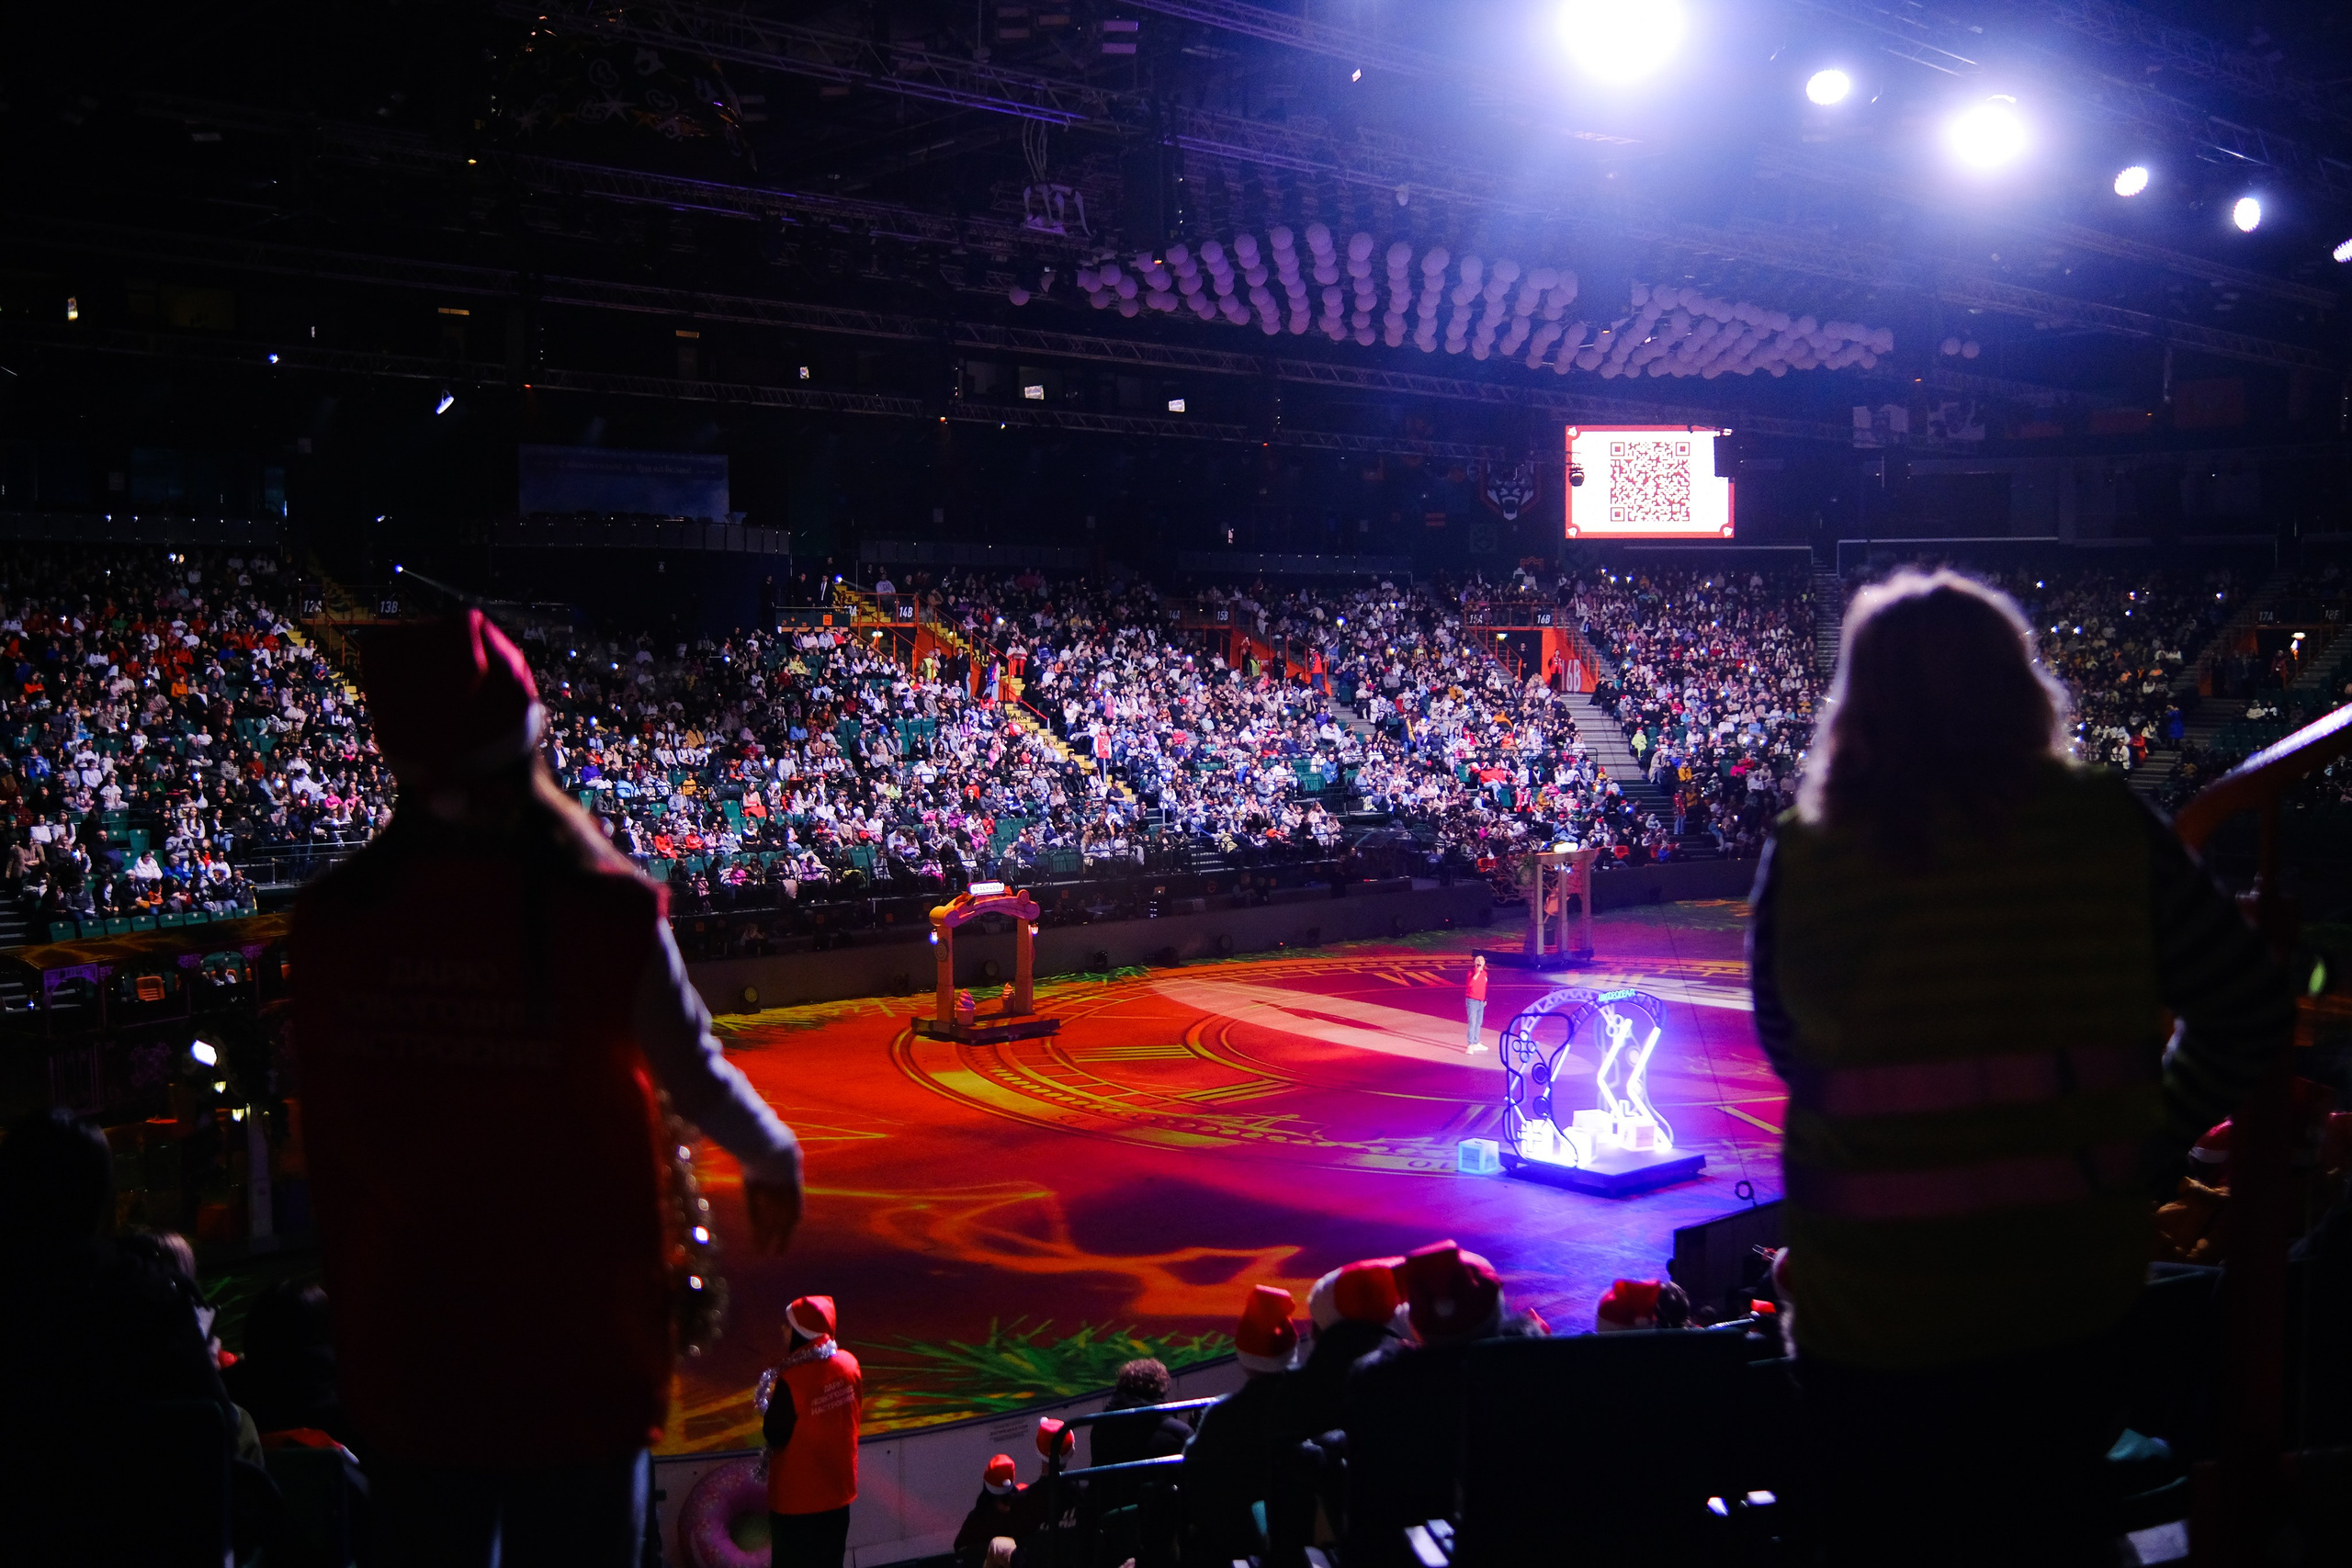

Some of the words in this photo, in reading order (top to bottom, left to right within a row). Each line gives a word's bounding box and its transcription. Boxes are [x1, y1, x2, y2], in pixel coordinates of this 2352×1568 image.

[380, 601, 399, 614] 13B
[899, 606, 913, 618] 14B
[1216, 610, 1228, 621] 15B
[1536, 614, 1551, 624] 16B
